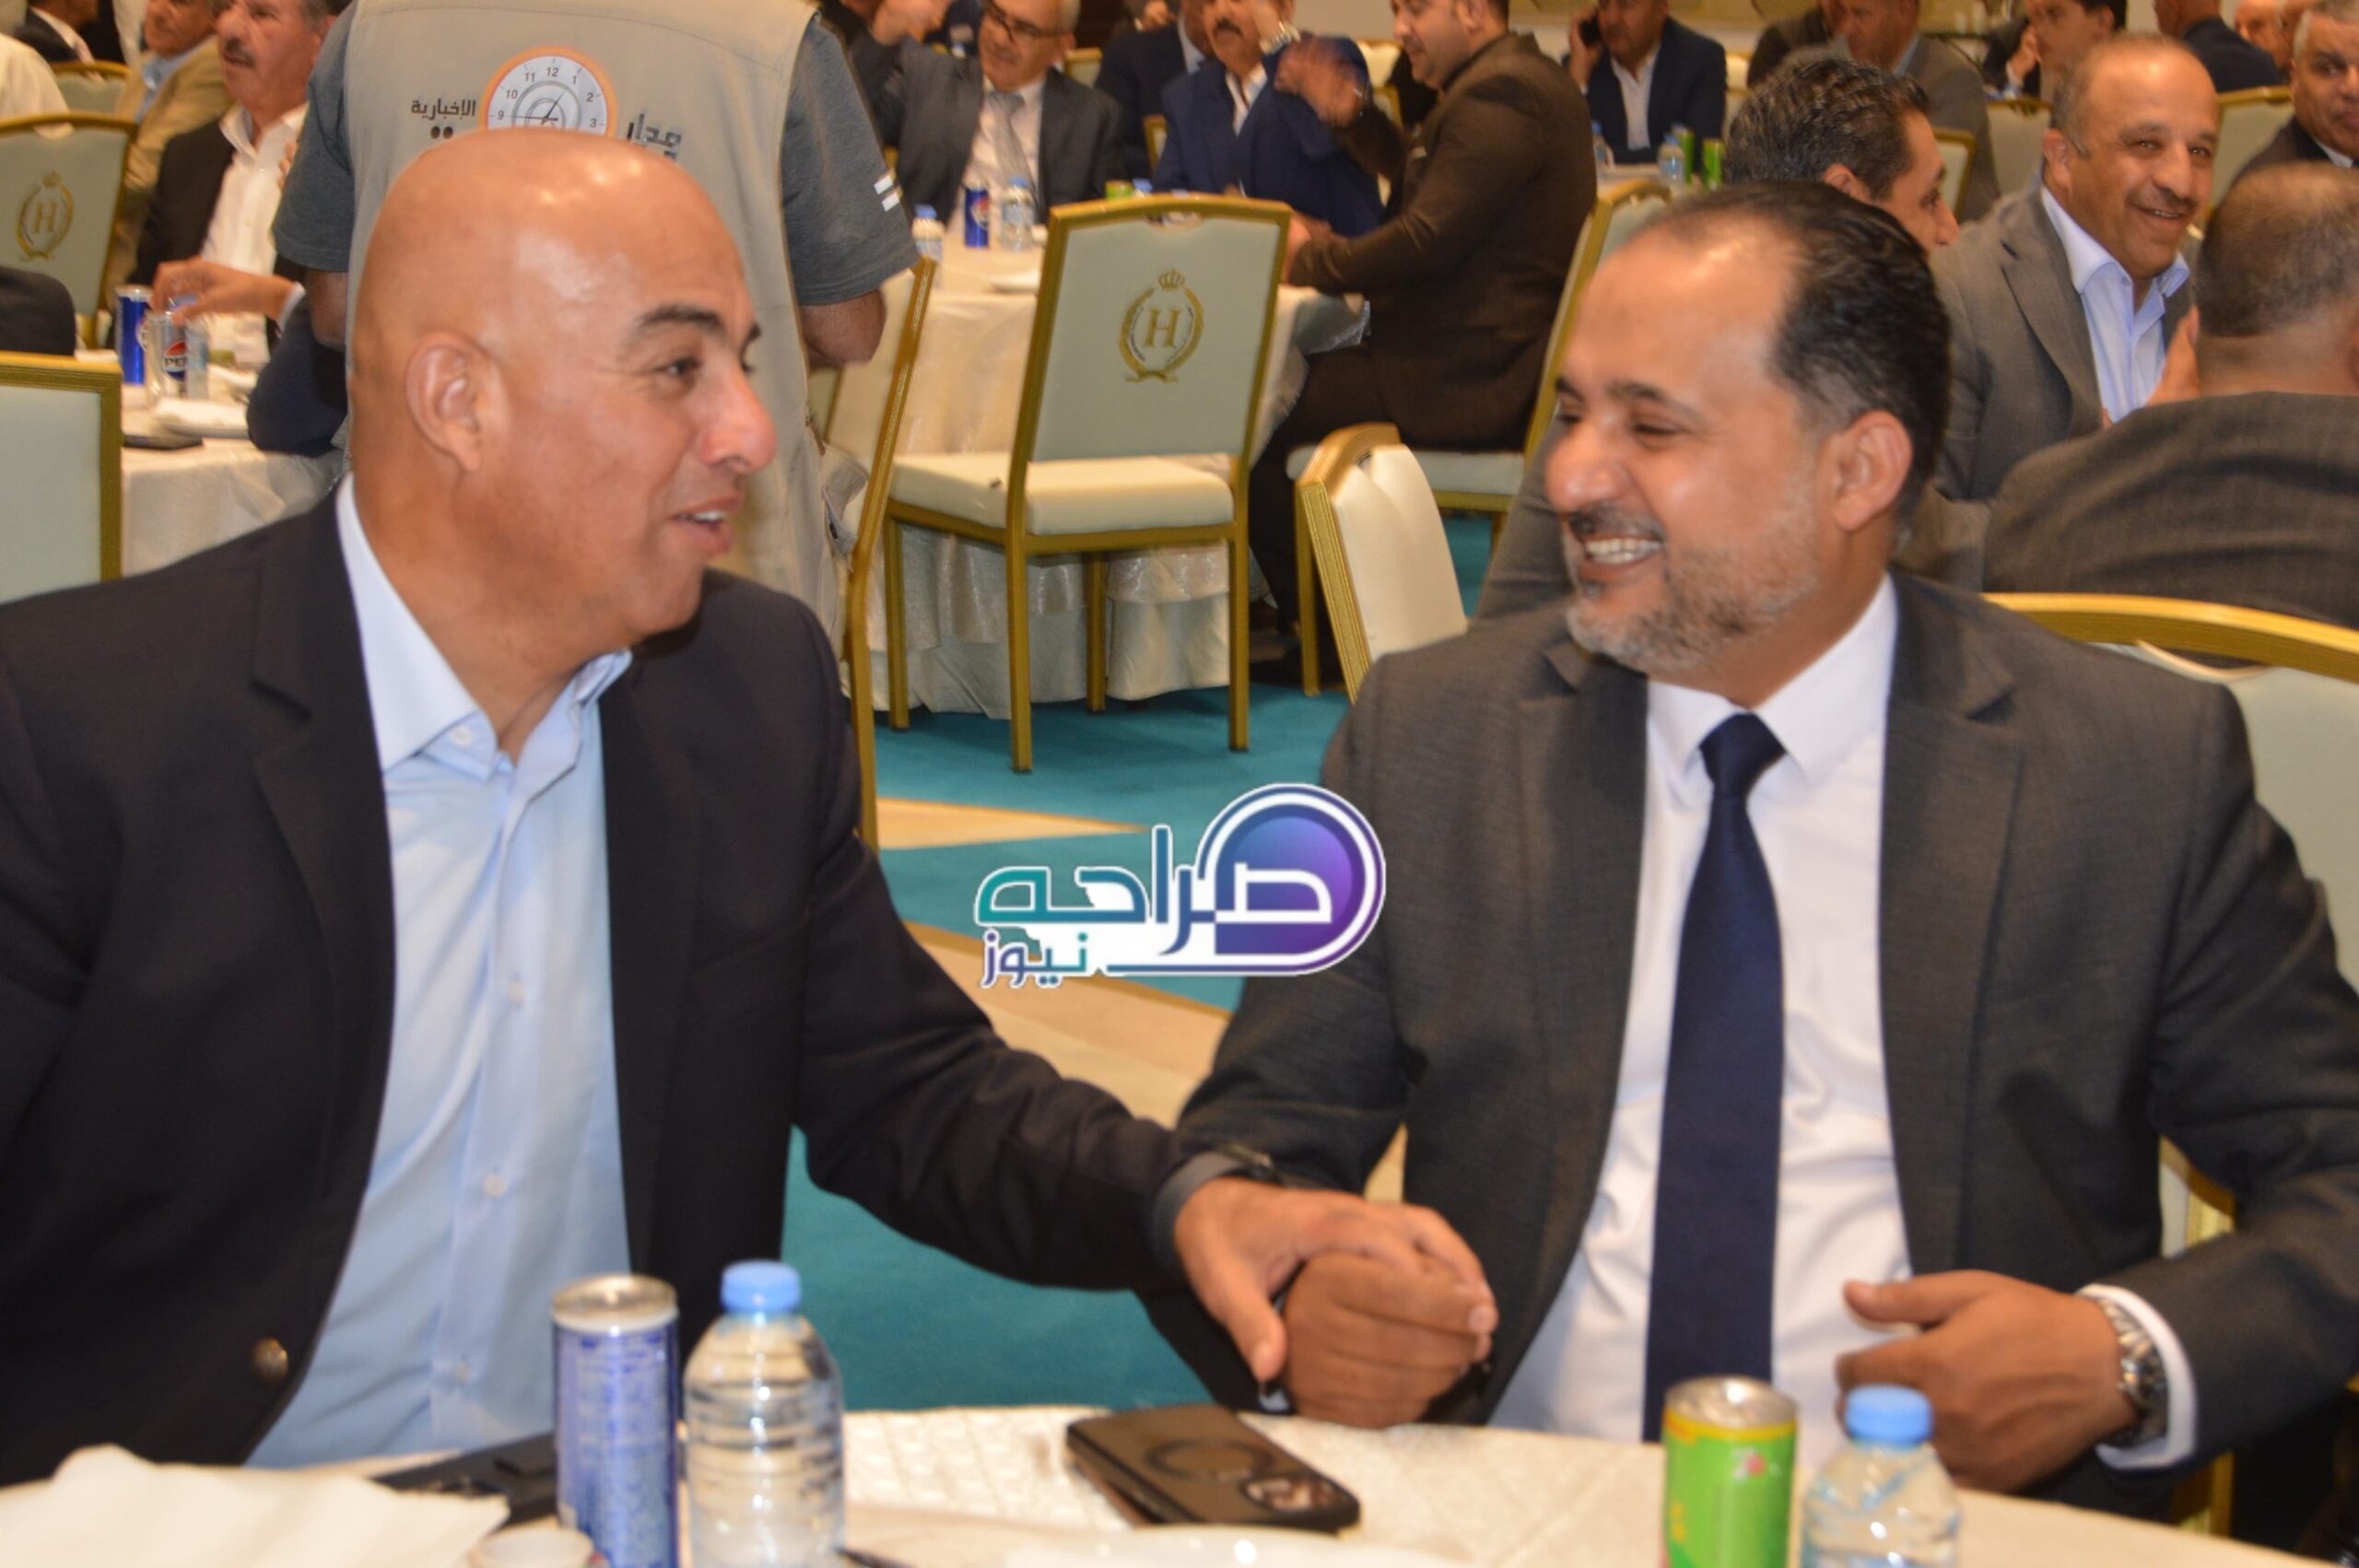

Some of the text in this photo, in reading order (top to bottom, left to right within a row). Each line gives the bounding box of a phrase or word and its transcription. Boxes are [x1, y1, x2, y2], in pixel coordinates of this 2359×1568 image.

[546, 67, 559, 76] 12
[524, 73, 535, 82] 11
[572, 76, 577, 85] 1
[506, 89, 518, 99] 10
[586, 93, 594, 102] 2
[411, 99, 475, 121] الإخبارية
[498, 111, 504, 120] 9
[590, 119, 597, 128] 3
[32, 200, 58, 234] H
[1143, 309, 1182, 347] H
